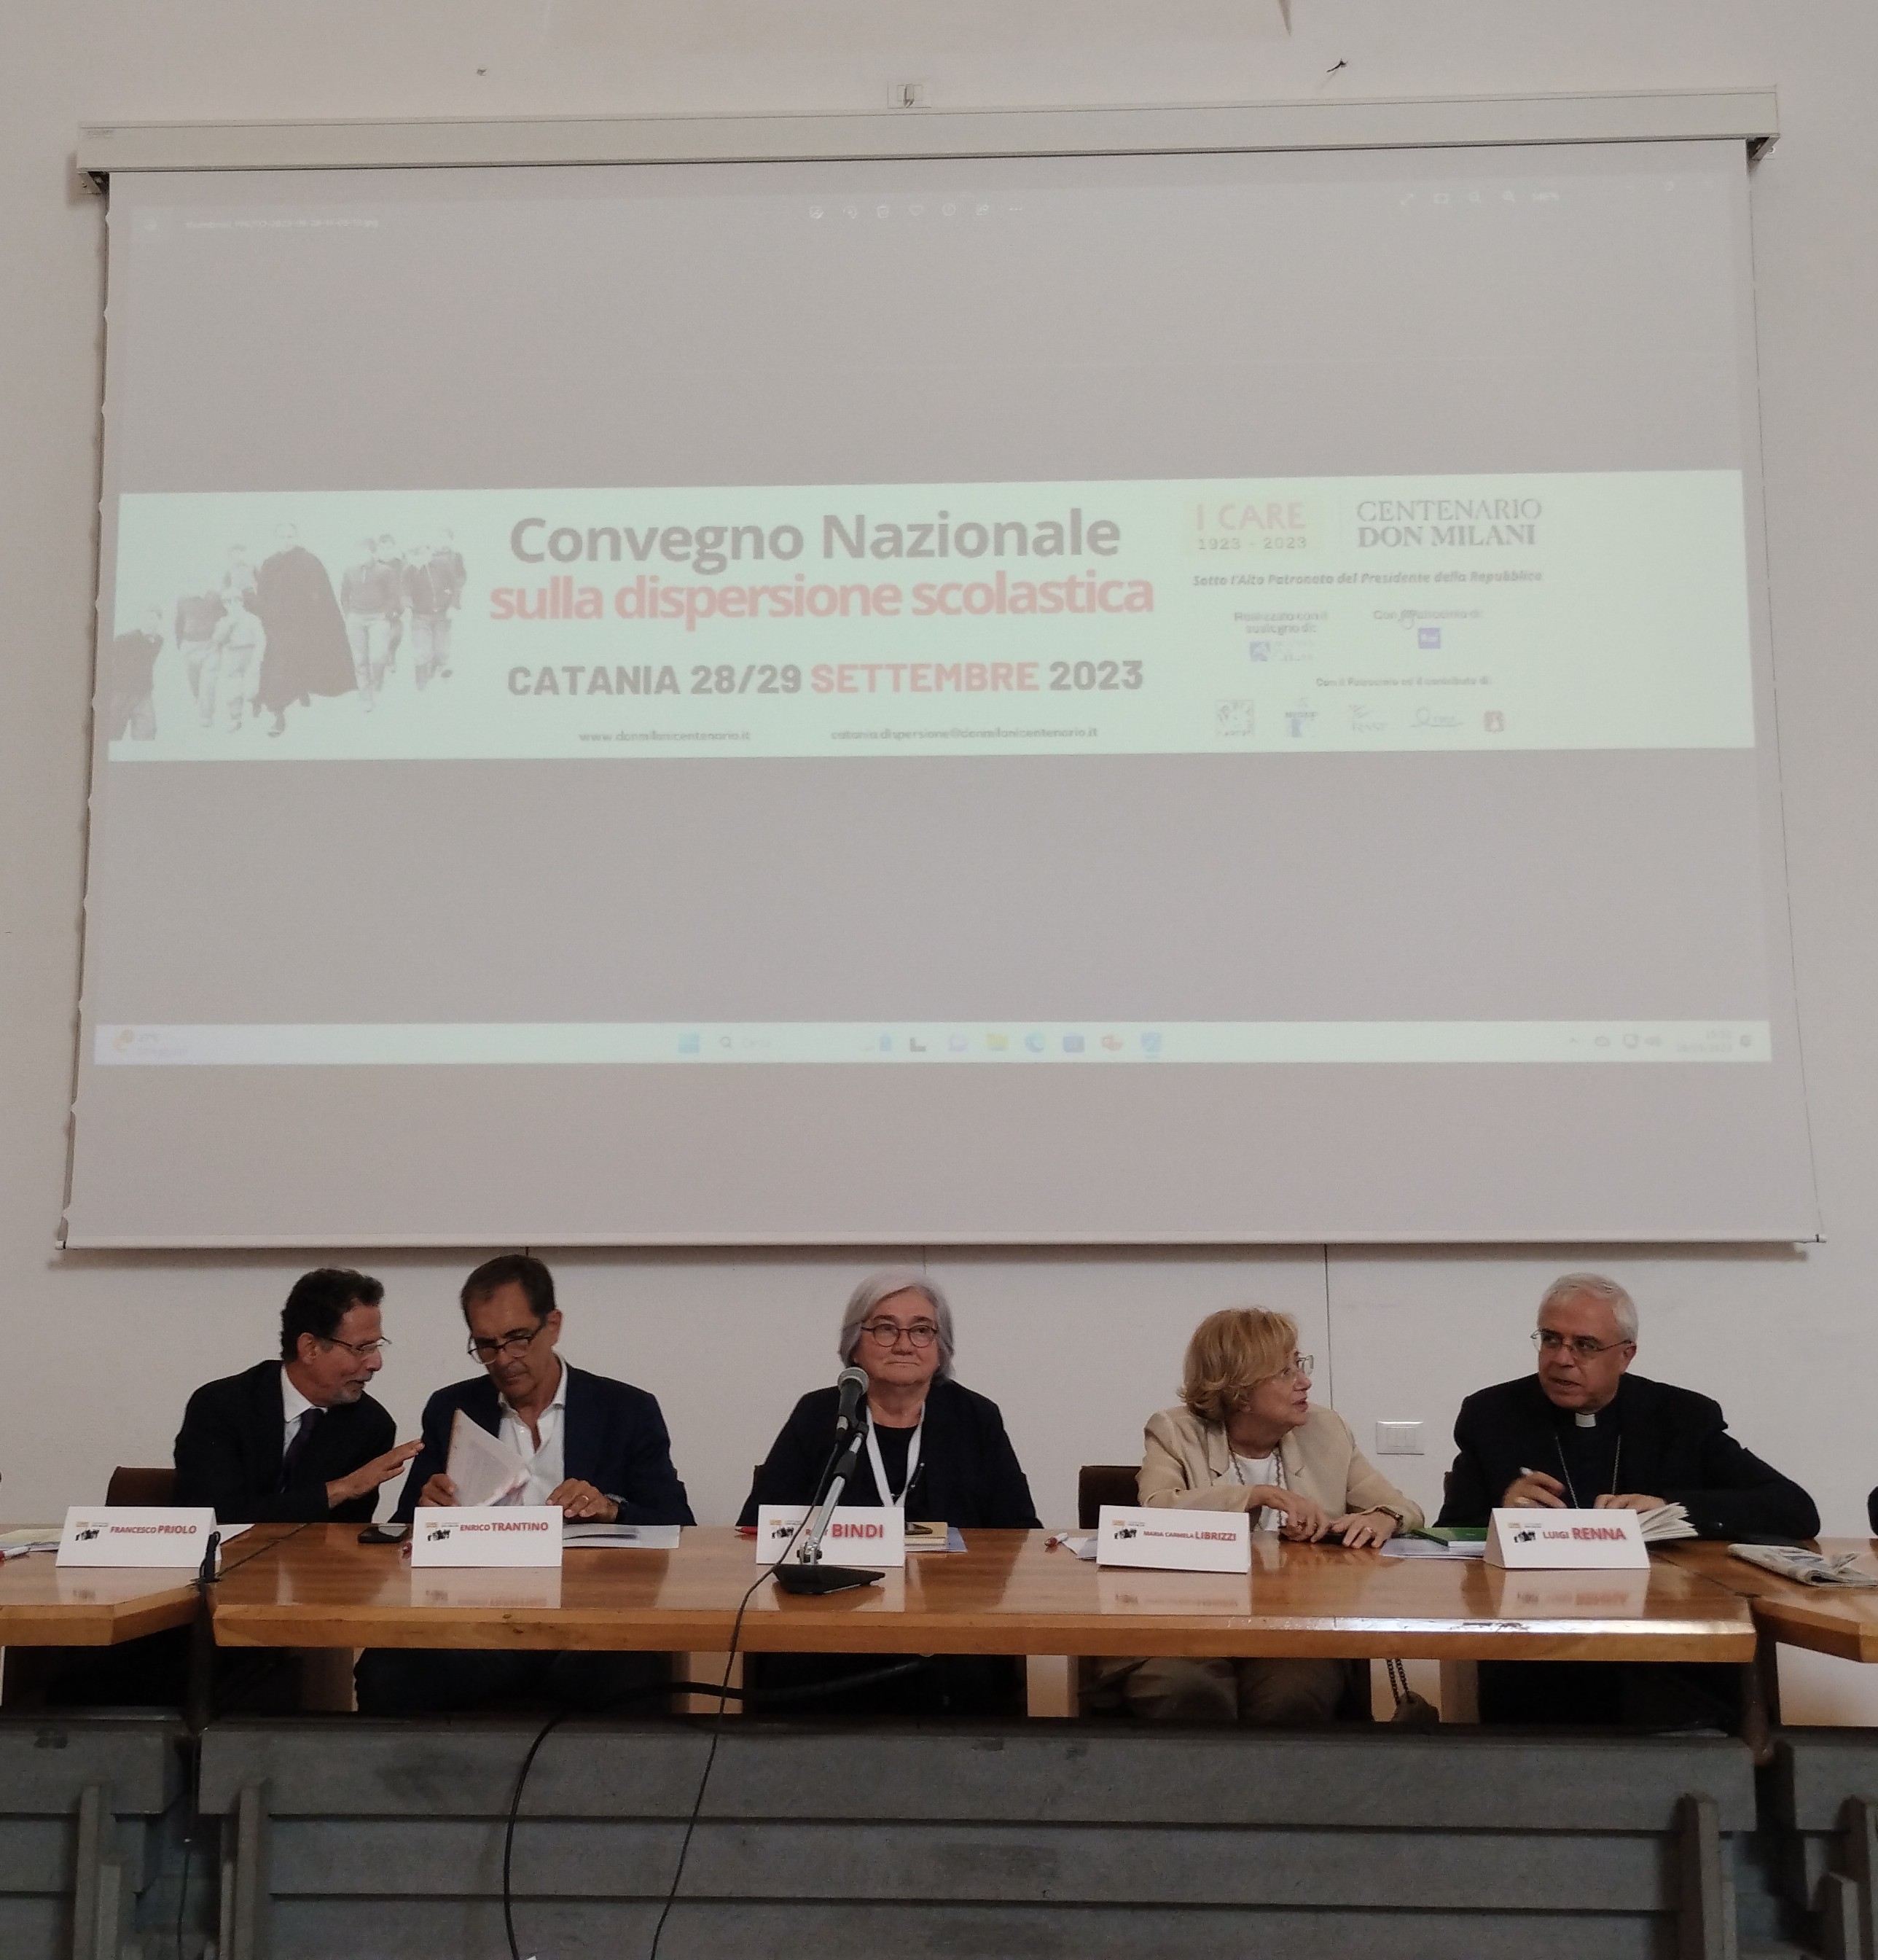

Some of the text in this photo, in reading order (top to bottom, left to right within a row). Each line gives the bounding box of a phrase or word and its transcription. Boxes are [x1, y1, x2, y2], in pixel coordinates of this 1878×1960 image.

[1196, 501, 1306, 531] I CARE
[1356, 499, 1543, 522] CENTENARIO
[510, 508, 1121, 574] Convegno Nazionale
[1197, 537, 1241, 550] 1923
[1263, 536, 1307, 550] 2023
[1358, 523, 1536, 548] DON MILANI
[1192, 575, 1227, 587] Sotto
[1268, 573, 1334, 585] Patronato
[1337, 572, 1358, 584] del
[1361, 571, 1431, 584] Presidente
[1433, 571, 1466, 583] della
[490, 570, 1154, 632] sulla dispersione scolastica
[507, 660, 1143, 696] CATANIA 28/29 SETTEMBRE 2023
[157, 1525, 197, 1534] PRIOLO
[491, 1522, 549, 1531] TRANTINO
[832, 1523, 884, 1538] BINDI
[1542, 1527, 1627, 1541] LUIGI RENNA
[1194, 1531, 1237, 1542] LIBRIZZI
